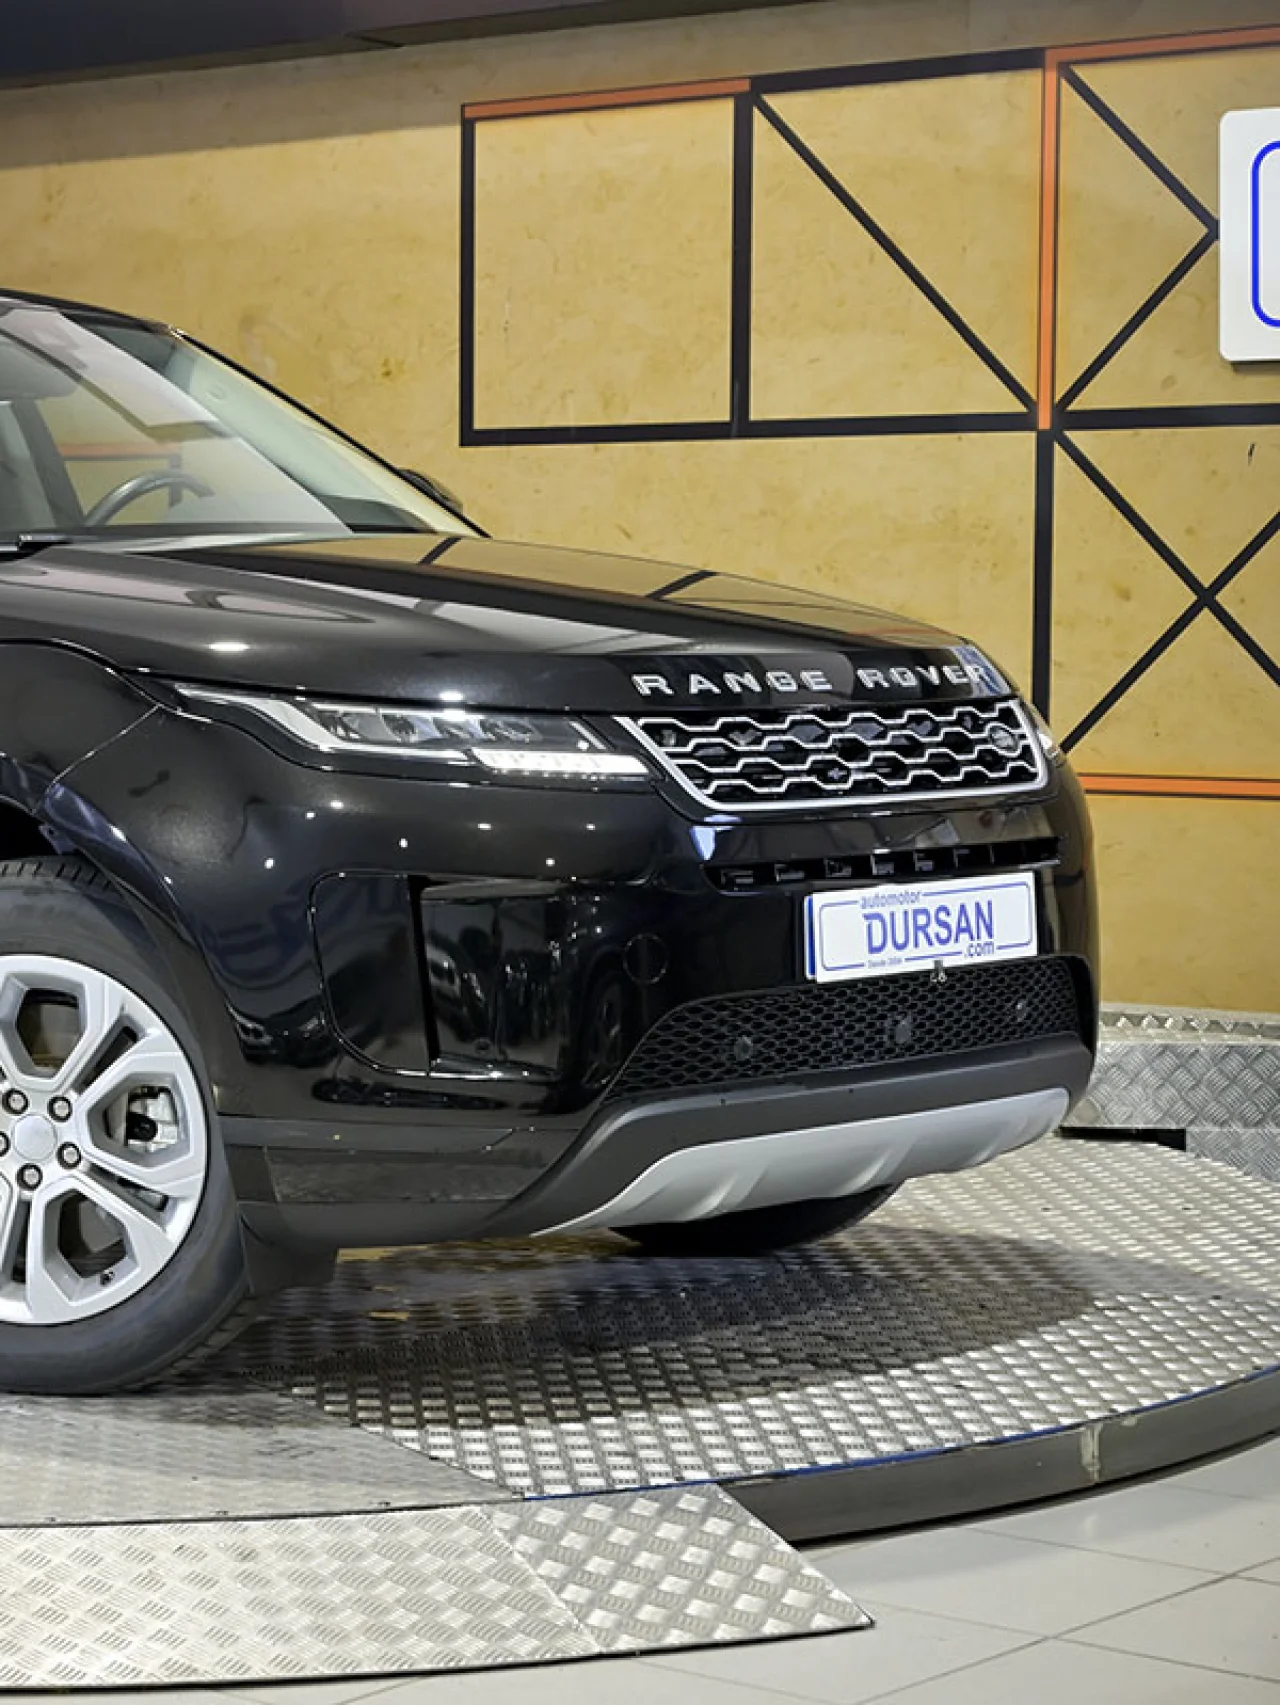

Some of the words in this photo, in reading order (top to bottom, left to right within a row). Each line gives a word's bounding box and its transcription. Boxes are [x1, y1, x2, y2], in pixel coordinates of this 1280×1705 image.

[631, 671, 833, 696] RANGE
[856, 665, 993, 690] ROVER
[863, 900, 993, 954] DURSAN
[964, 940, 995, 958] .com
